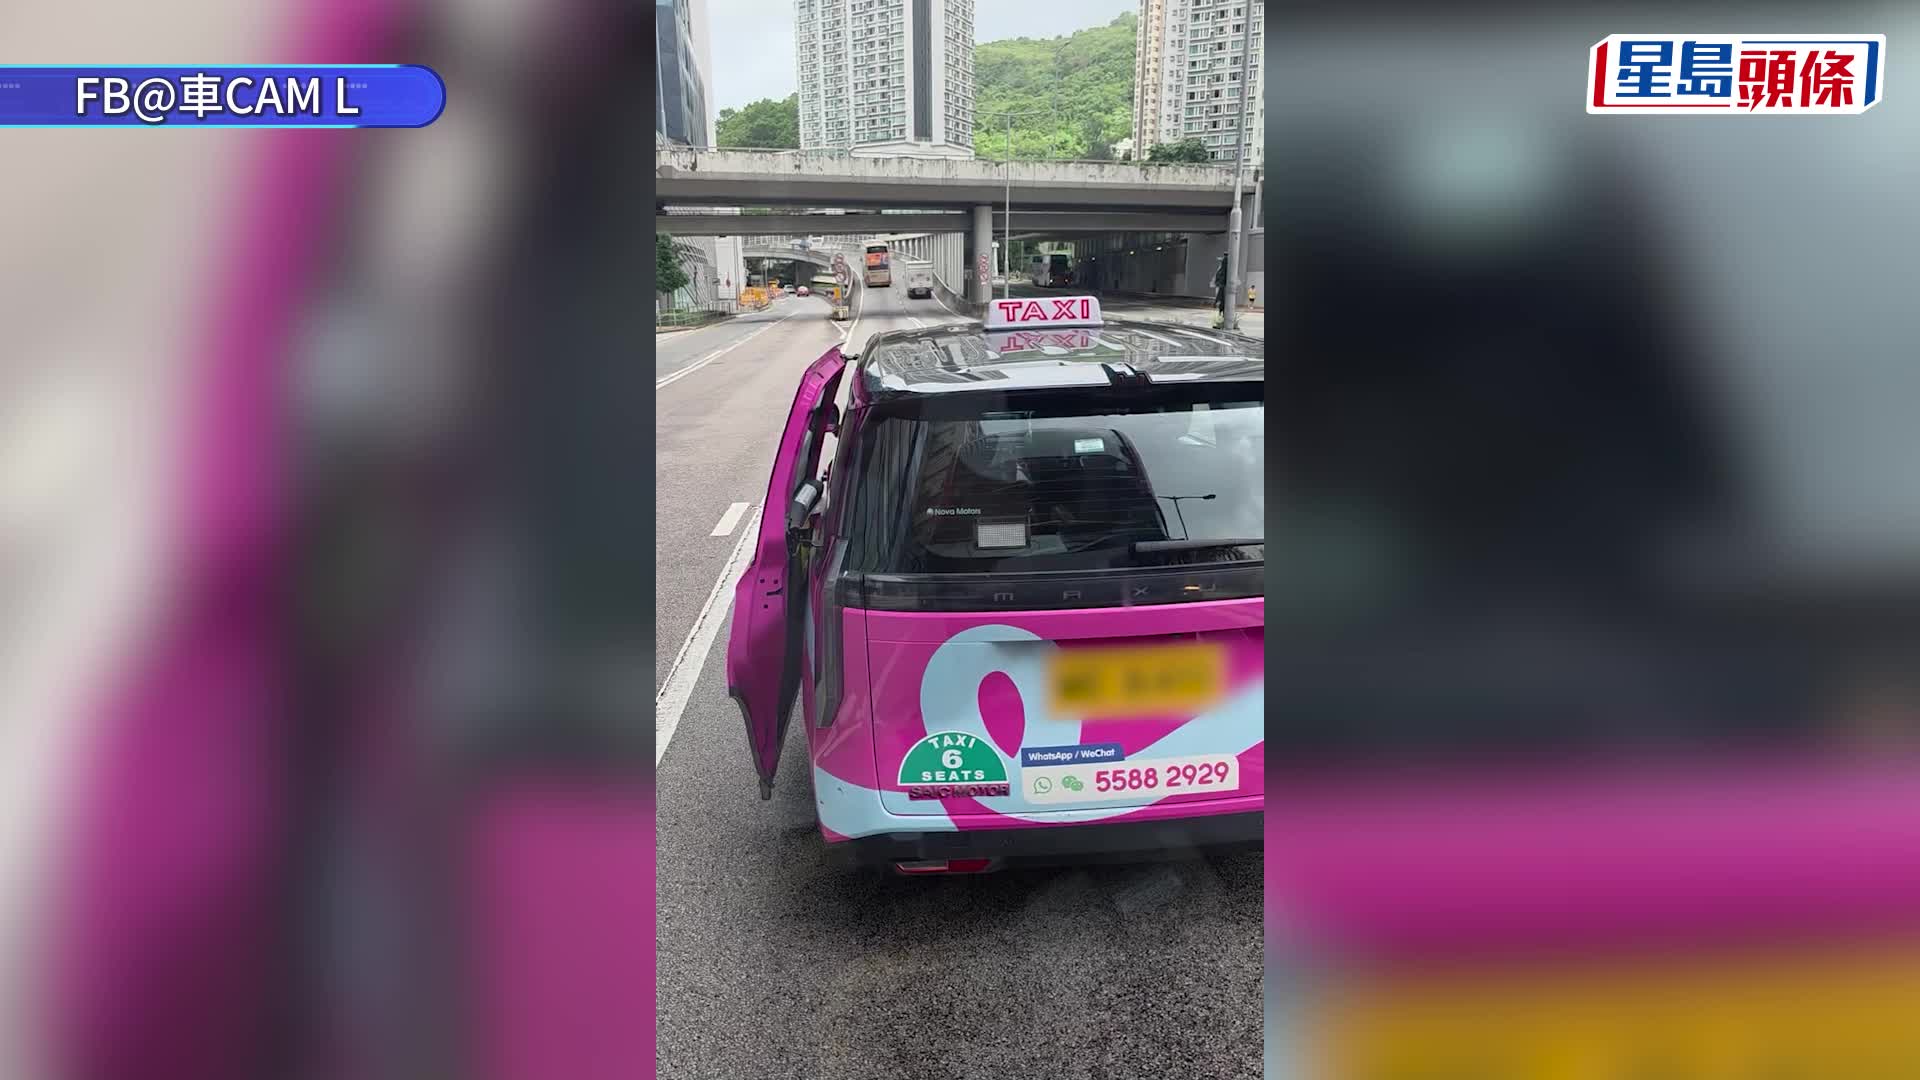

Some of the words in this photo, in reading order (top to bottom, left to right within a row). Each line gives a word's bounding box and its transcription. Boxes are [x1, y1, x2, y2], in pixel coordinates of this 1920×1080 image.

[998, 299, 1090, 322] TAXI
[934, 508, 955, 516] Nova
[956, 507, 981, 515] Motors
[928, 734, 976, 749] TAXI
[941, 749, 964, 769] 6
[1028, 750, 1073, 762] WhatsApp
[1081, 748, 1116, 758] WeChat
[921, 769, 985, 781] SEATS
[1095, 768, 1158, 792] 5588
[1166, 762, 1229, 787] 2929
